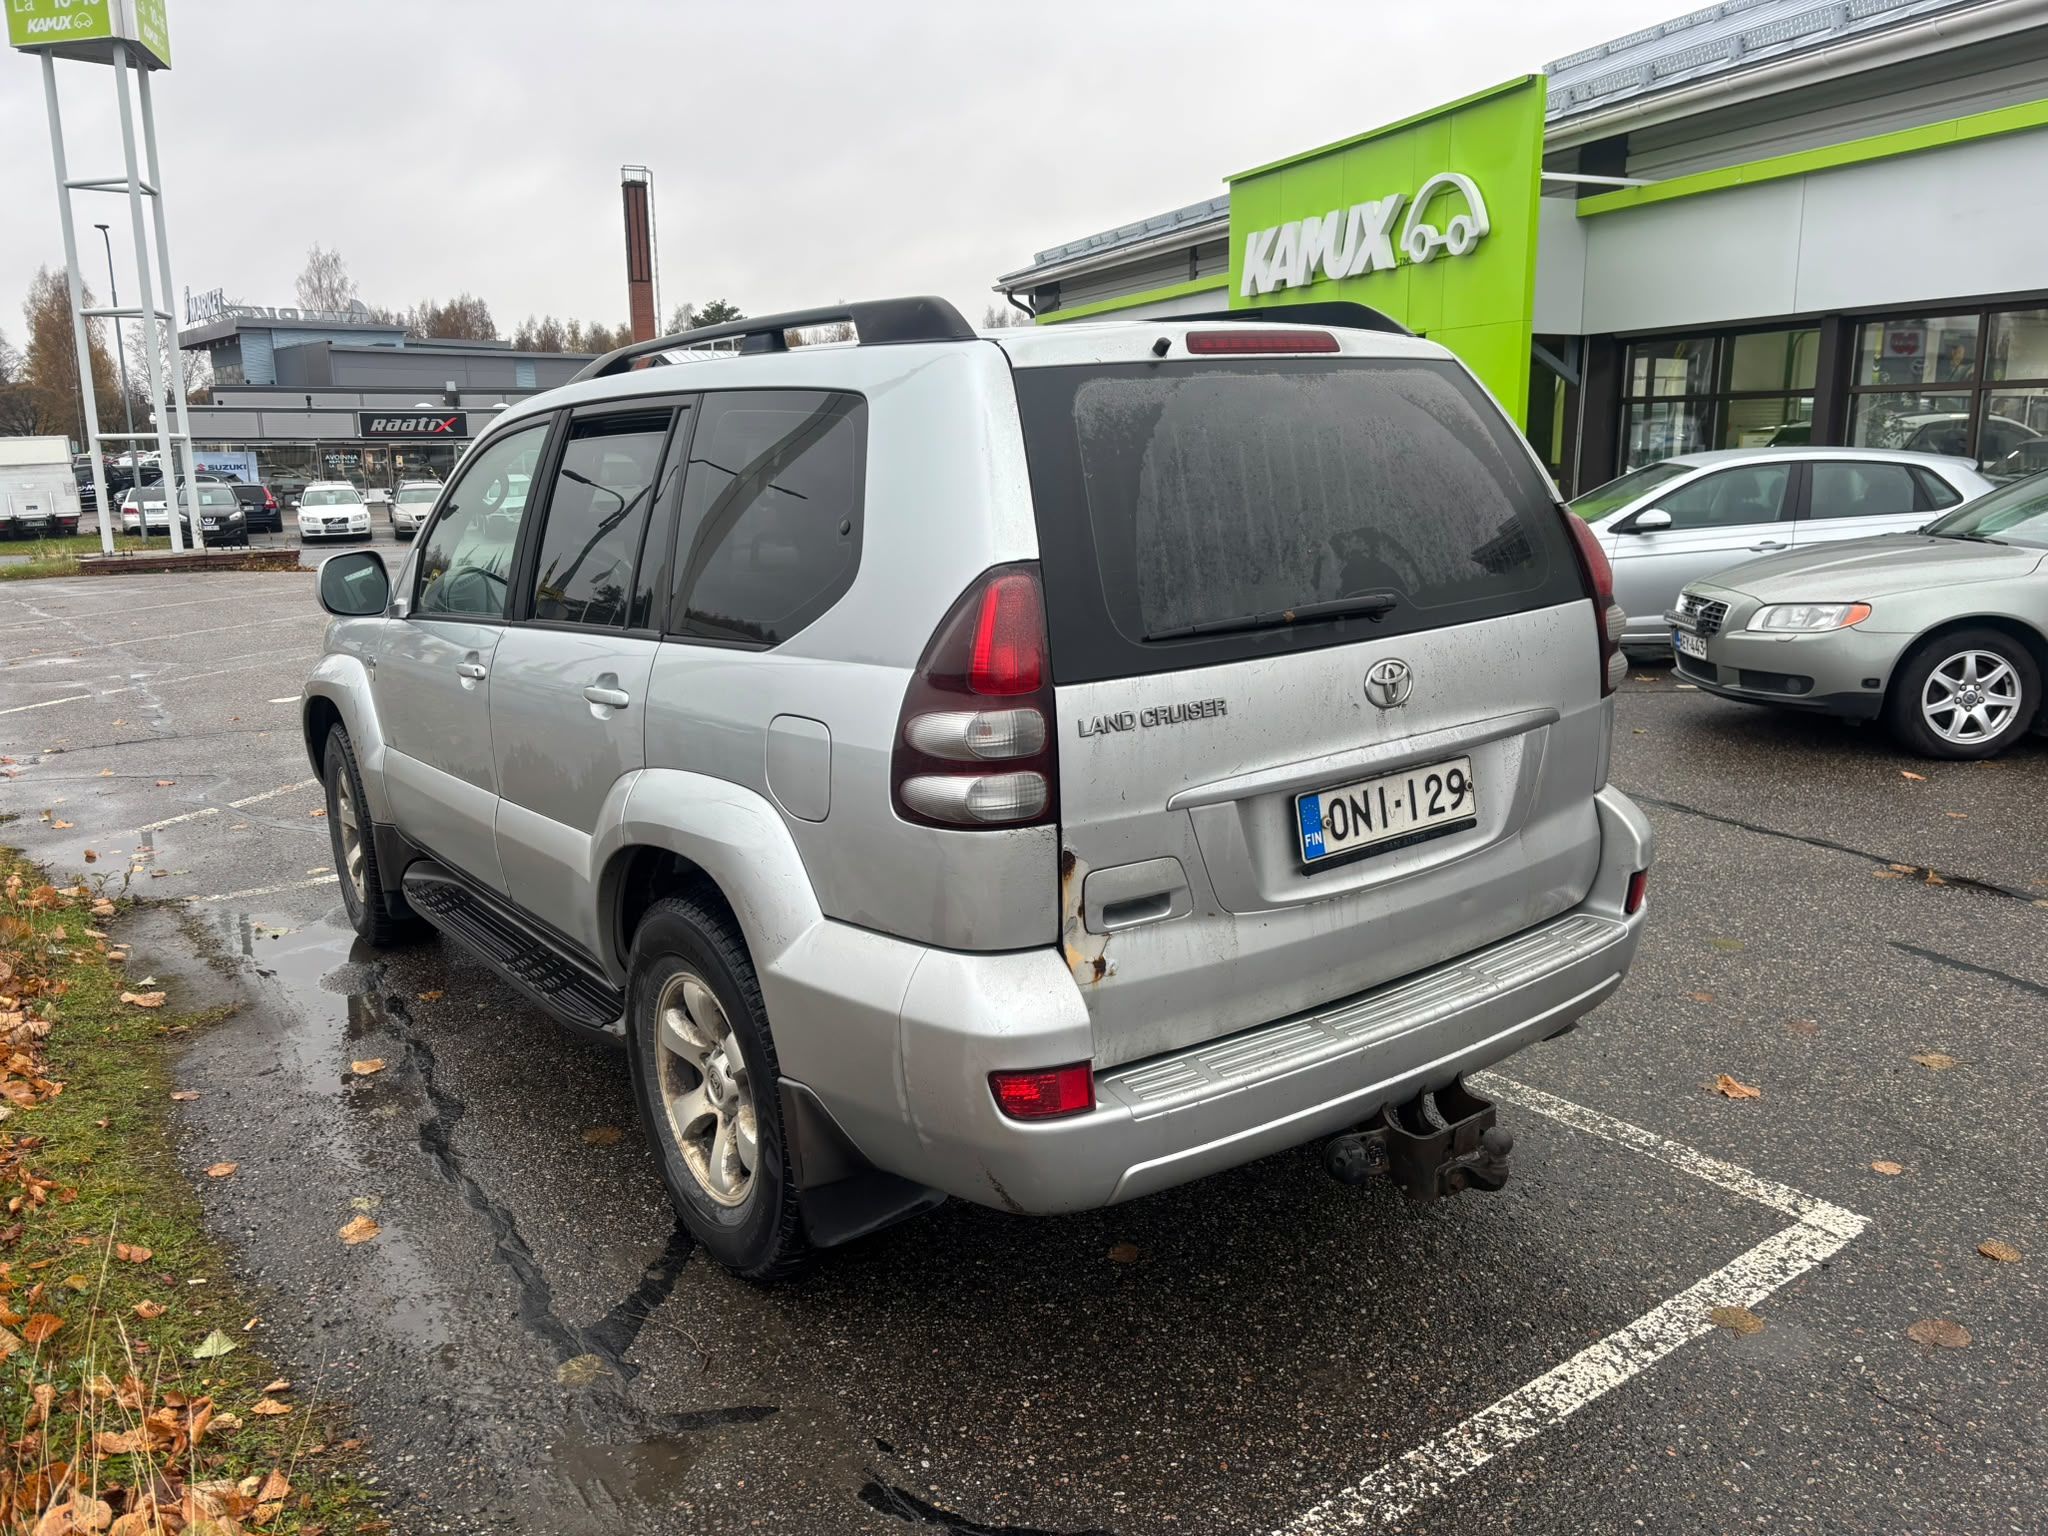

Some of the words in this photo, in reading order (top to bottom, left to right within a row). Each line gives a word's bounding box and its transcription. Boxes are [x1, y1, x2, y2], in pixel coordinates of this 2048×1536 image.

[27, 15, 72, 33] KAMUX
[1240, 193, 1407, 297] KAMUX
[1078, 711, 1137, 738] LAND
[1140, 697, 1228, 728] CRUISER
[1328, 768, 1466, 841] ONI-129
[1304, 830, 1323, 848] FIN
